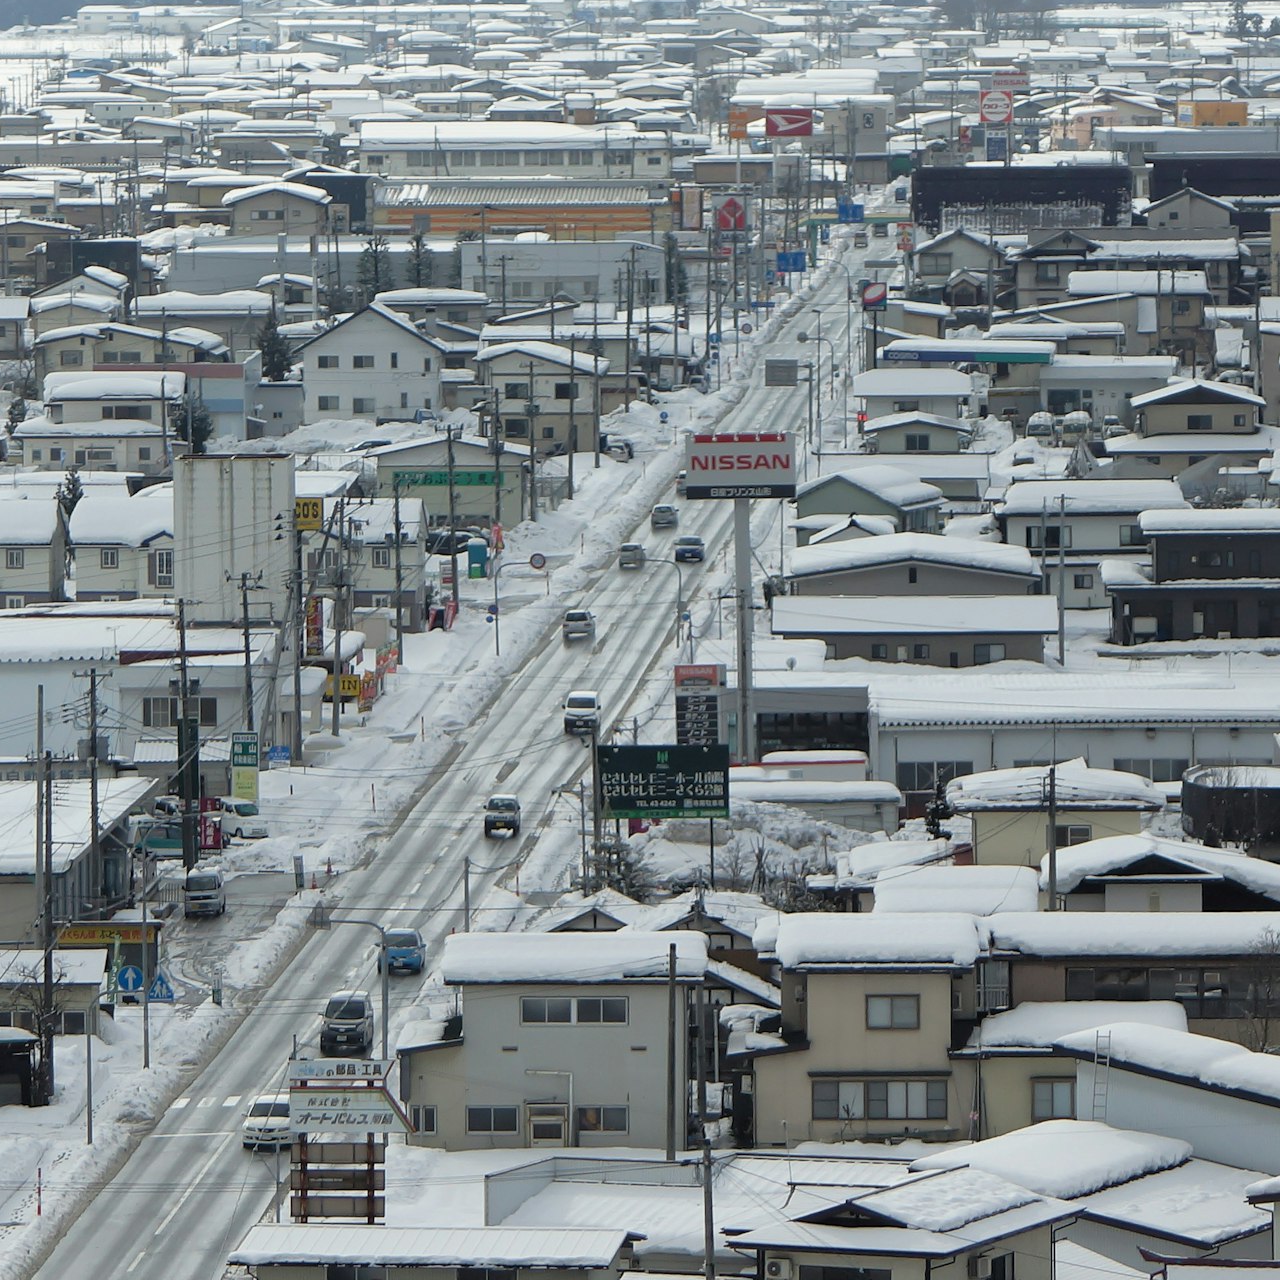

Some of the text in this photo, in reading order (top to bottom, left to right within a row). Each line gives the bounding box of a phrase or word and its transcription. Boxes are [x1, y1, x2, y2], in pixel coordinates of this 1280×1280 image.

[691, 454, 790, 471] NISSAN
[341, 679, 358, 690] IN
[307, 1097, 351, 1107] 株式会社
